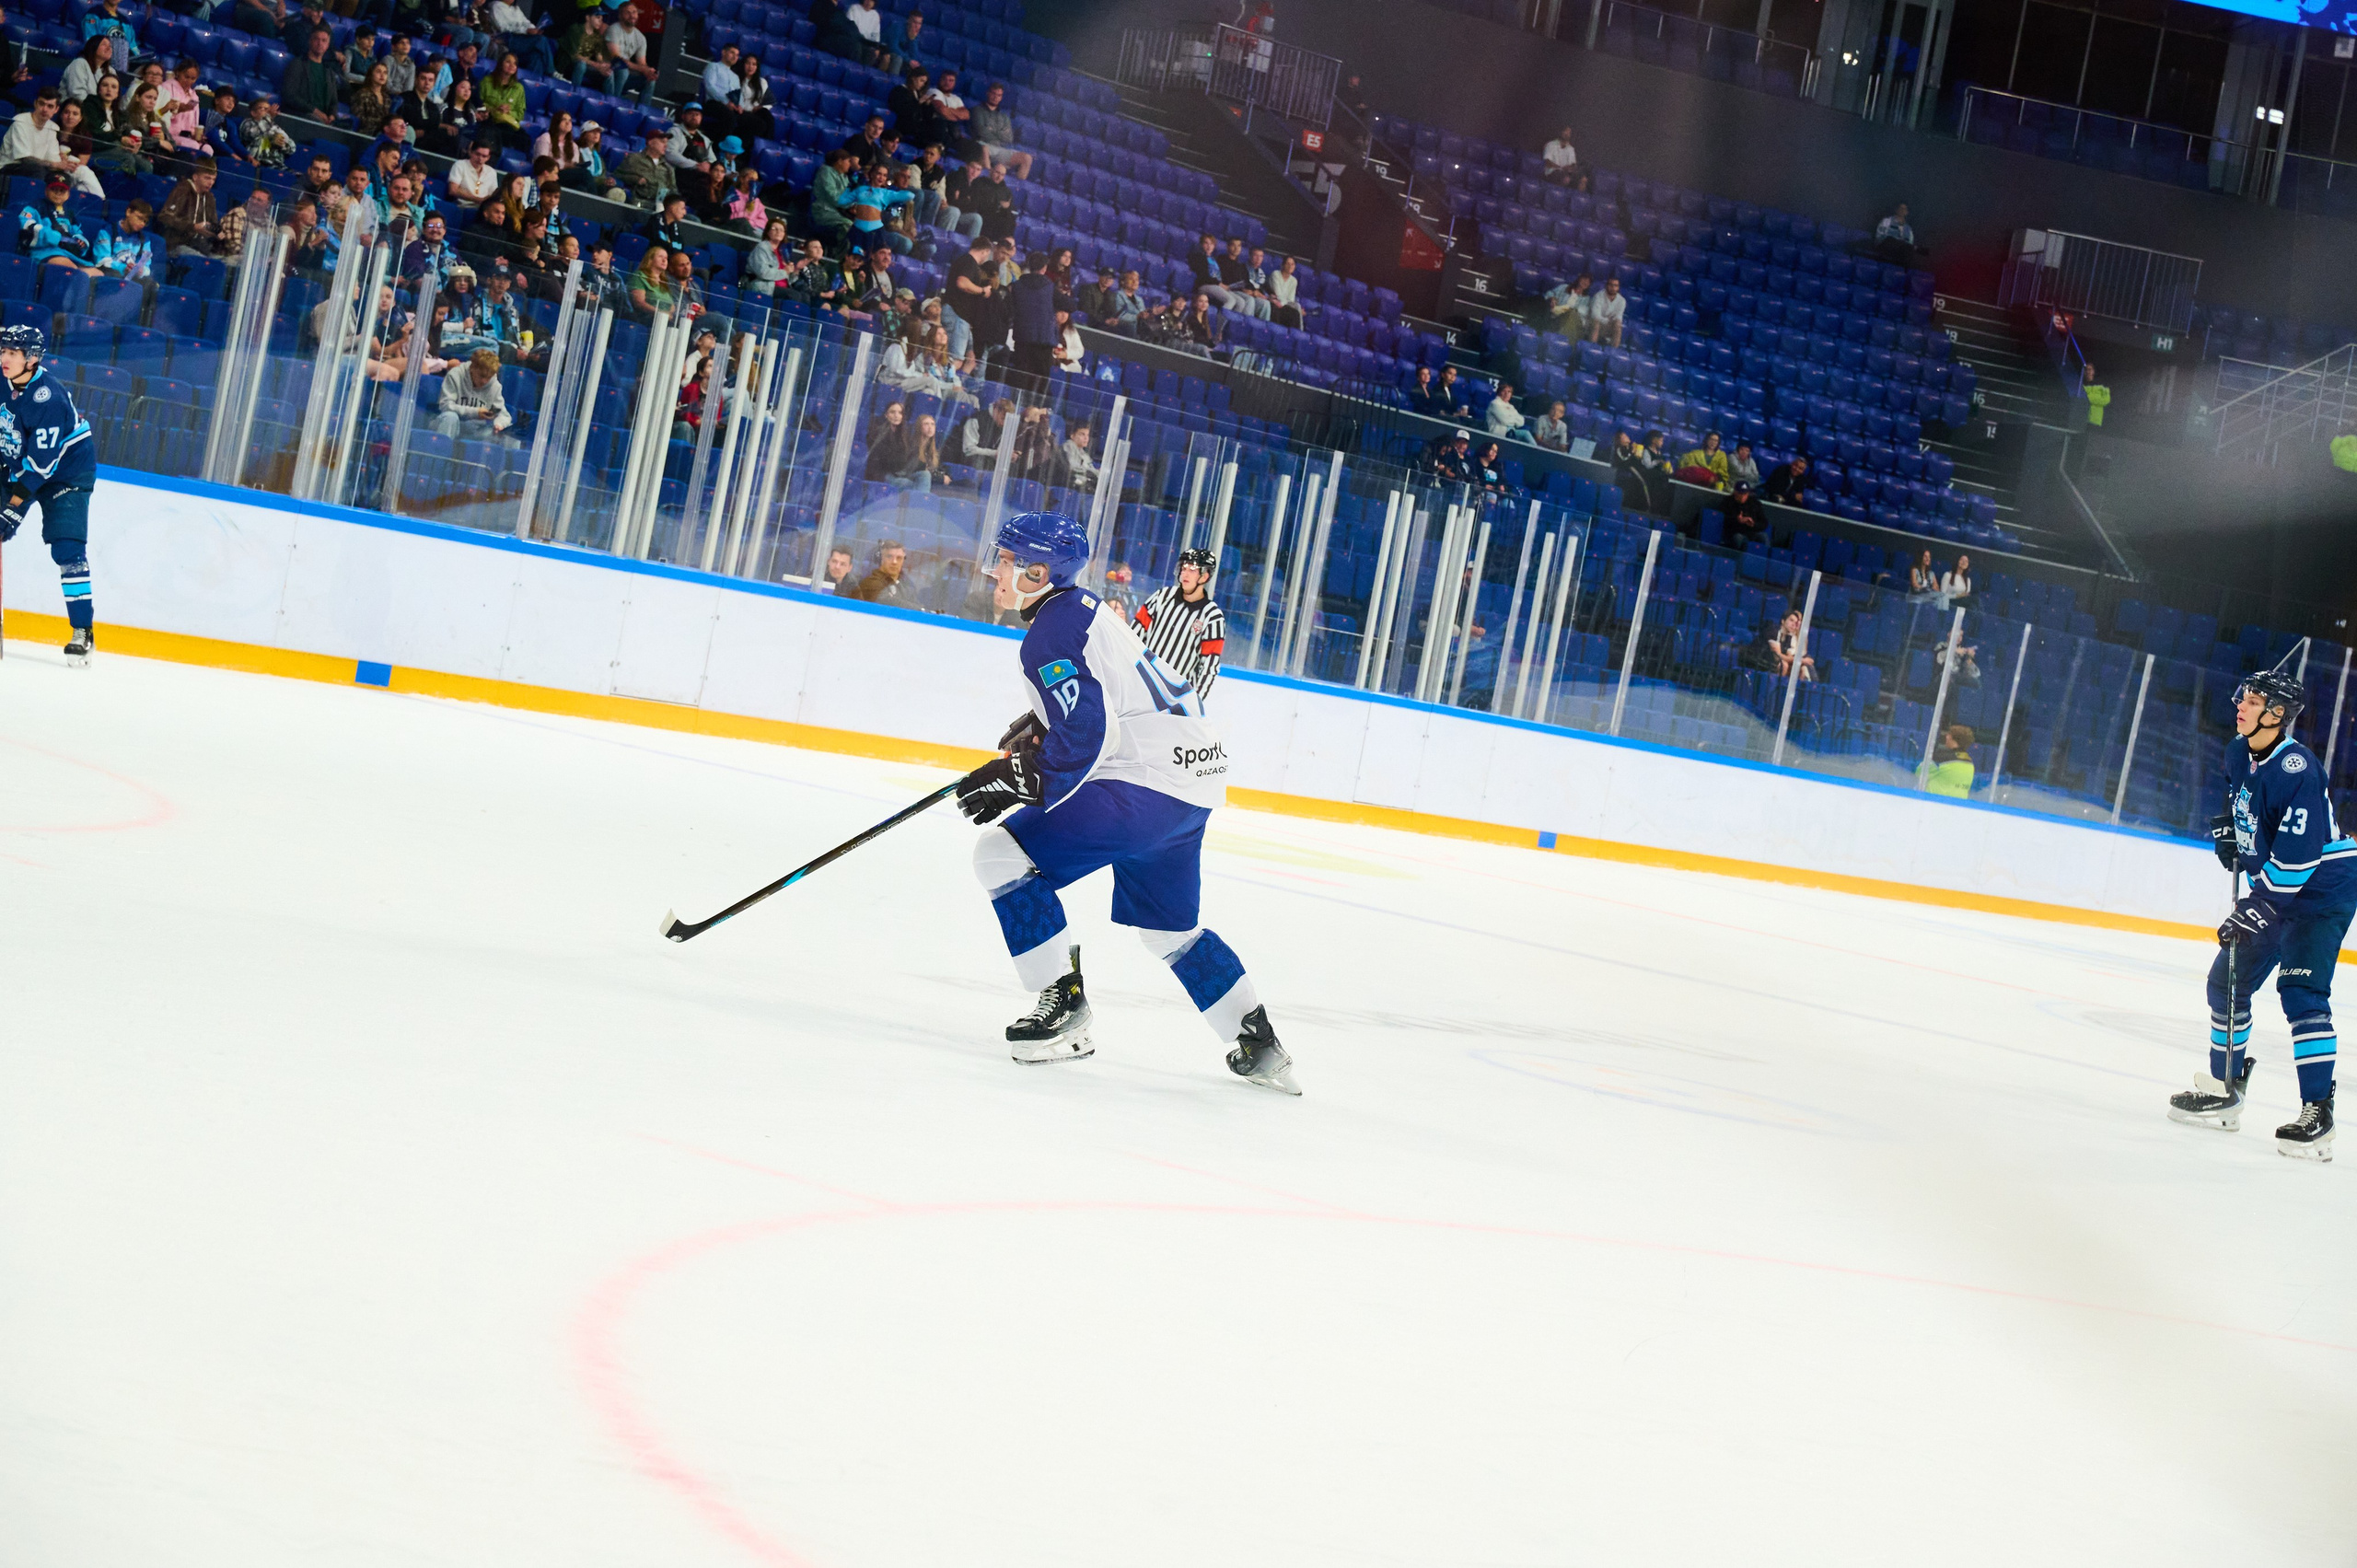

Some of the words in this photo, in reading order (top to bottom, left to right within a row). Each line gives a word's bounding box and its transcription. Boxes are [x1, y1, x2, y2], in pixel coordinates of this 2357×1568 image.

[1306, 134, 1321, 148] E5
[1475, 278, 1488, 292] 16
[1933, 296, 1945, 309] 19
[1446, 331, 1457, 345] 14
[2156, 337, 2173, 351] H1
[1973, 392, 1986, 405] 16
[36, 426, 60, 449] 27
[1051, 678, 1080, 721] 19
[2278, 806, 2309, 836] 23
